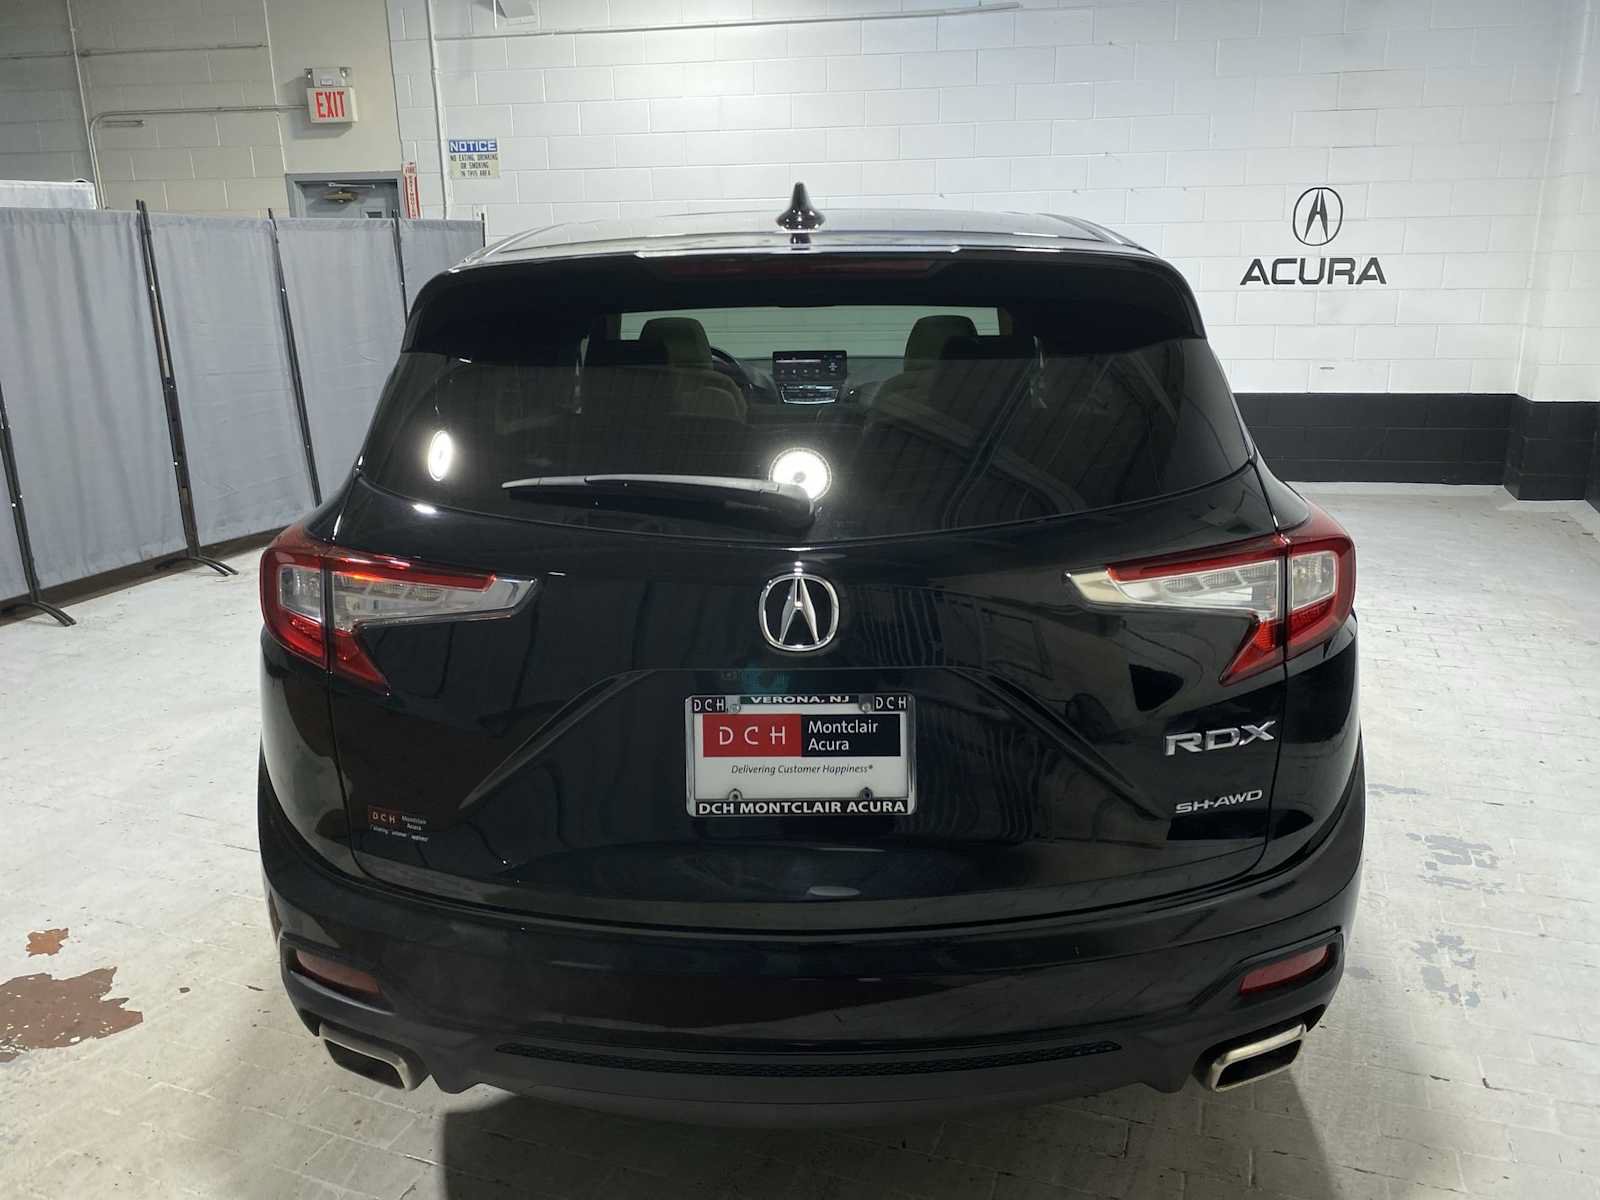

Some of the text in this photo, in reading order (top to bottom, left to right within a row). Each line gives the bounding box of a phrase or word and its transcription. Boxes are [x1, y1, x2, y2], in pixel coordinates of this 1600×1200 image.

[315, 91, 345, 118] EXIT
[450, 140, 497, 152] NOTICE
[450, 154, 457, 162] NO
[469, 161, 489, 169] SMOKING
[1240, 257, 1387, 286] ACURA
[693, 699, 725, 712] DCH
[750, 695, 850, 704] VERONA, NJ
[875, 696, 907, 709] DCH
[808, 719, 879, 734] Montclair
[719, 726, 786, 745] DCH
[1165, 720, 1276, 756] RDX
[808, 737, 850, 751] Acura
[731, 764, 776, 776] Delivering
[777, 764, 821, 774] Customer
[699, 800, 906, 815] DCH MONTCLAIR ACURA
[1175, 789, 1263, 814] SH-AWD
[372, 811, 396, 825] DCH
